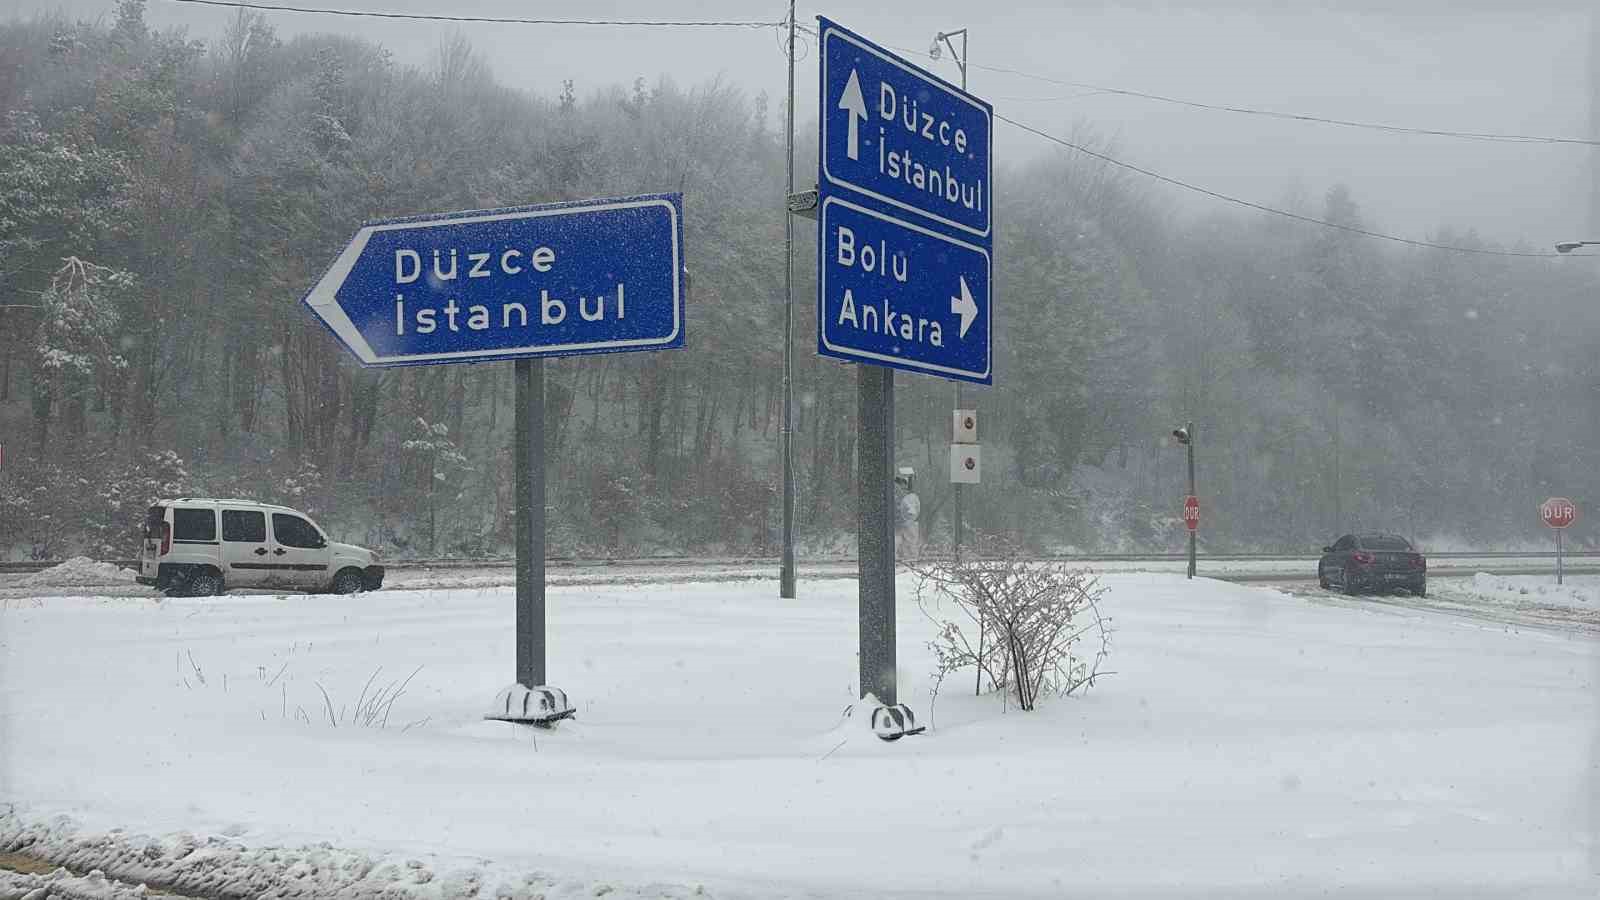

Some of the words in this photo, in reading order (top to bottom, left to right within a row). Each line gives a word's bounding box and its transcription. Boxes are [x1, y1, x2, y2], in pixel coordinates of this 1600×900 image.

[880, 81, 967, 154] Düzce
[879, 127, 982, 212] İstanbul
[395, 246, 556, 283] Düzce
[838, 225, 908, 282] Bolu
[396, 283, 625, 335] İstanbul
[838, 289, 944, 348] Ankara
[1185, 506, 1199, 520] DUR
[1544, 506, 1572, 519] DUR
